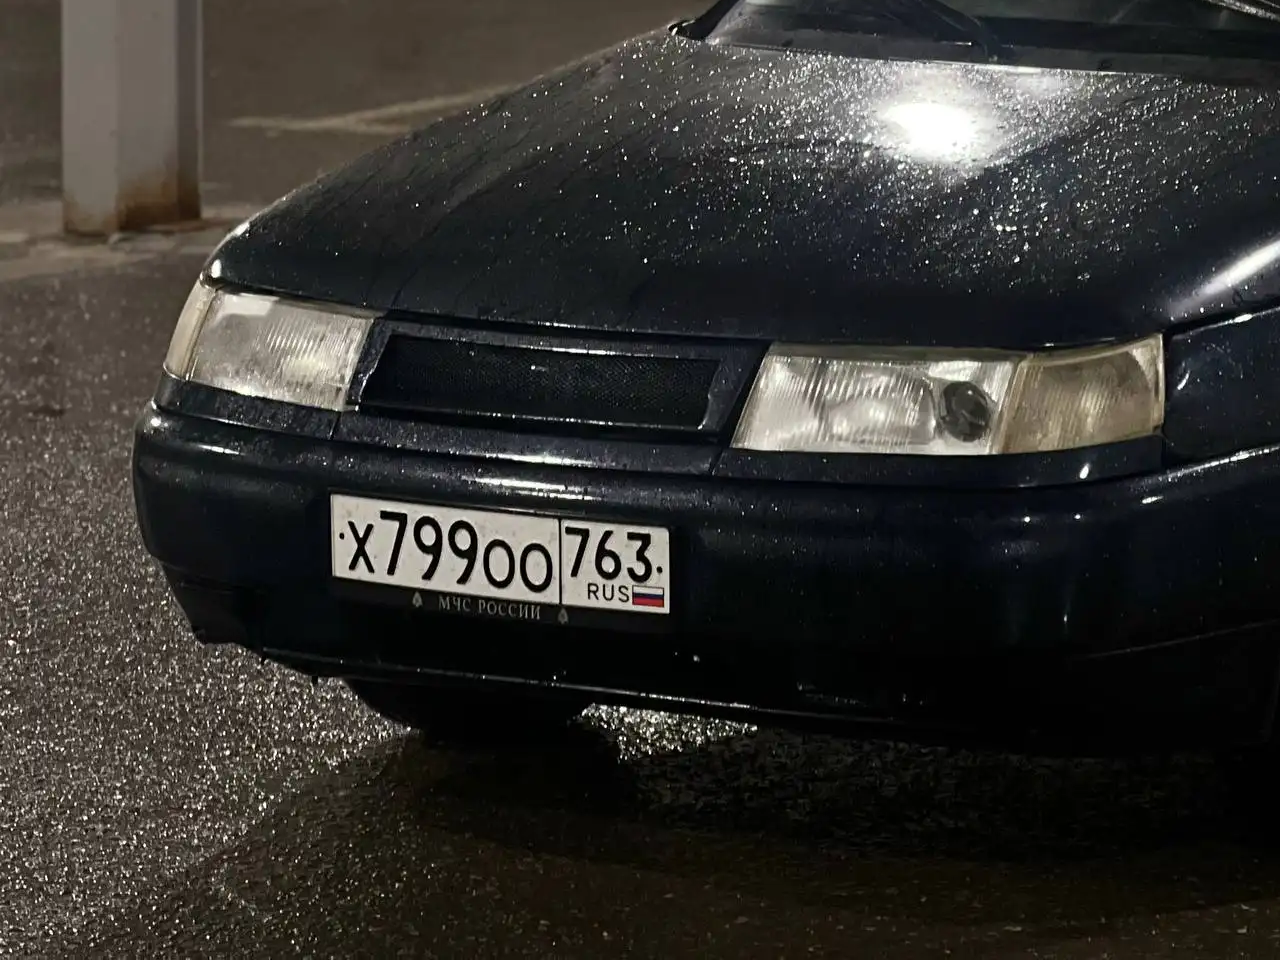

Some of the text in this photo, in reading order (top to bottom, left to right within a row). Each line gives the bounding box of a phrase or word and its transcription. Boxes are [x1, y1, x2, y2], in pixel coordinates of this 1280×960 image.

[564, 526, 653, 583] 763
[586, 582, 630, 603] RUS
[438, 595, 541, 620] МЧС РОССИИ
